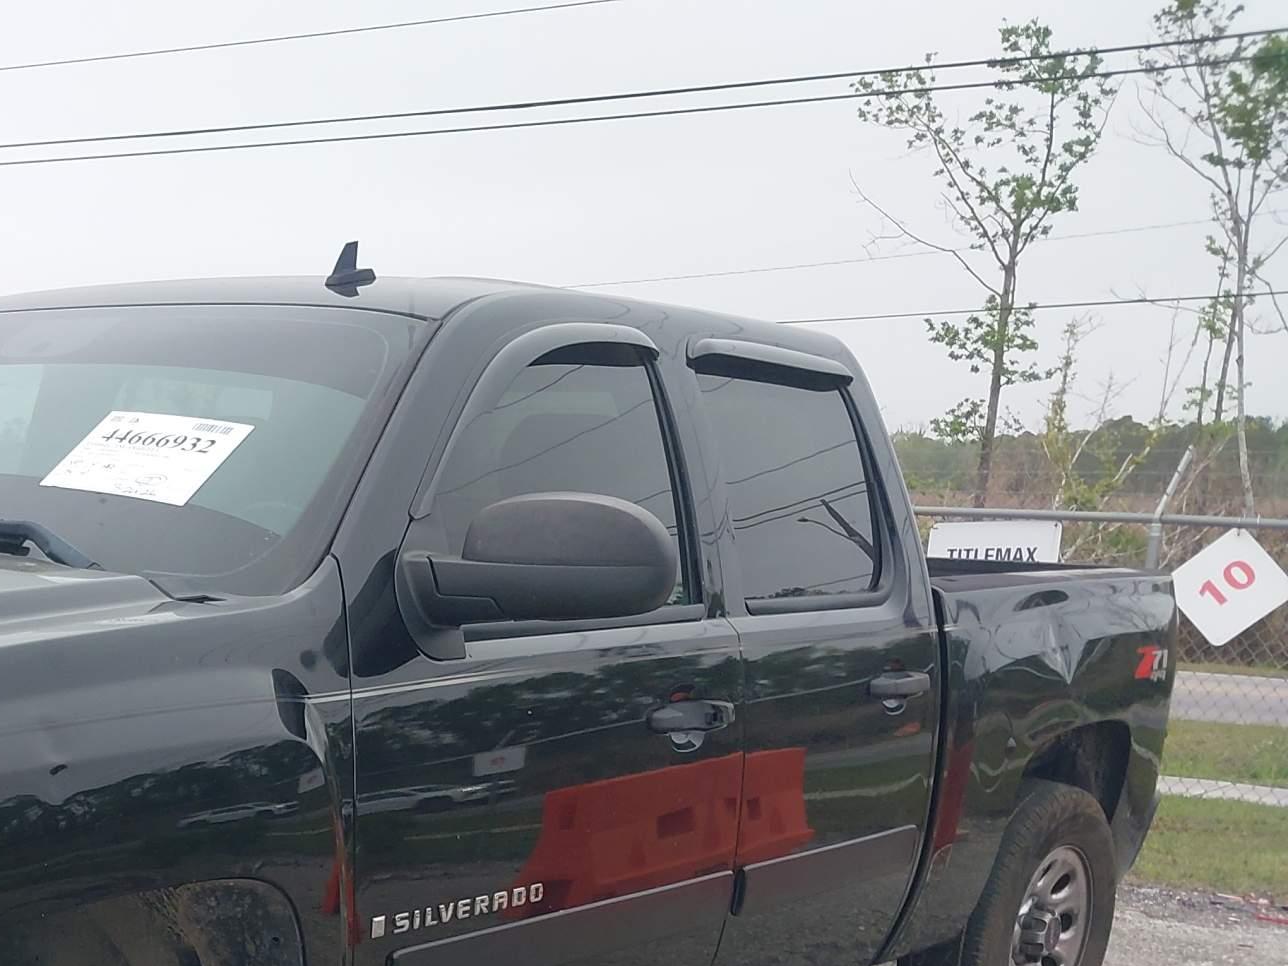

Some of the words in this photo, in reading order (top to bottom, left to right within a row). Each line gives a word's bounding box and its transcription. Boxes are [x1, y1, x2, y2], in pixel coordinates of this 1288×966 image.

[101, 427, 217, 454] 44666932
[1199, 560, 1256, 606] 10
[393, 882, 544, 934] SILVERADO
